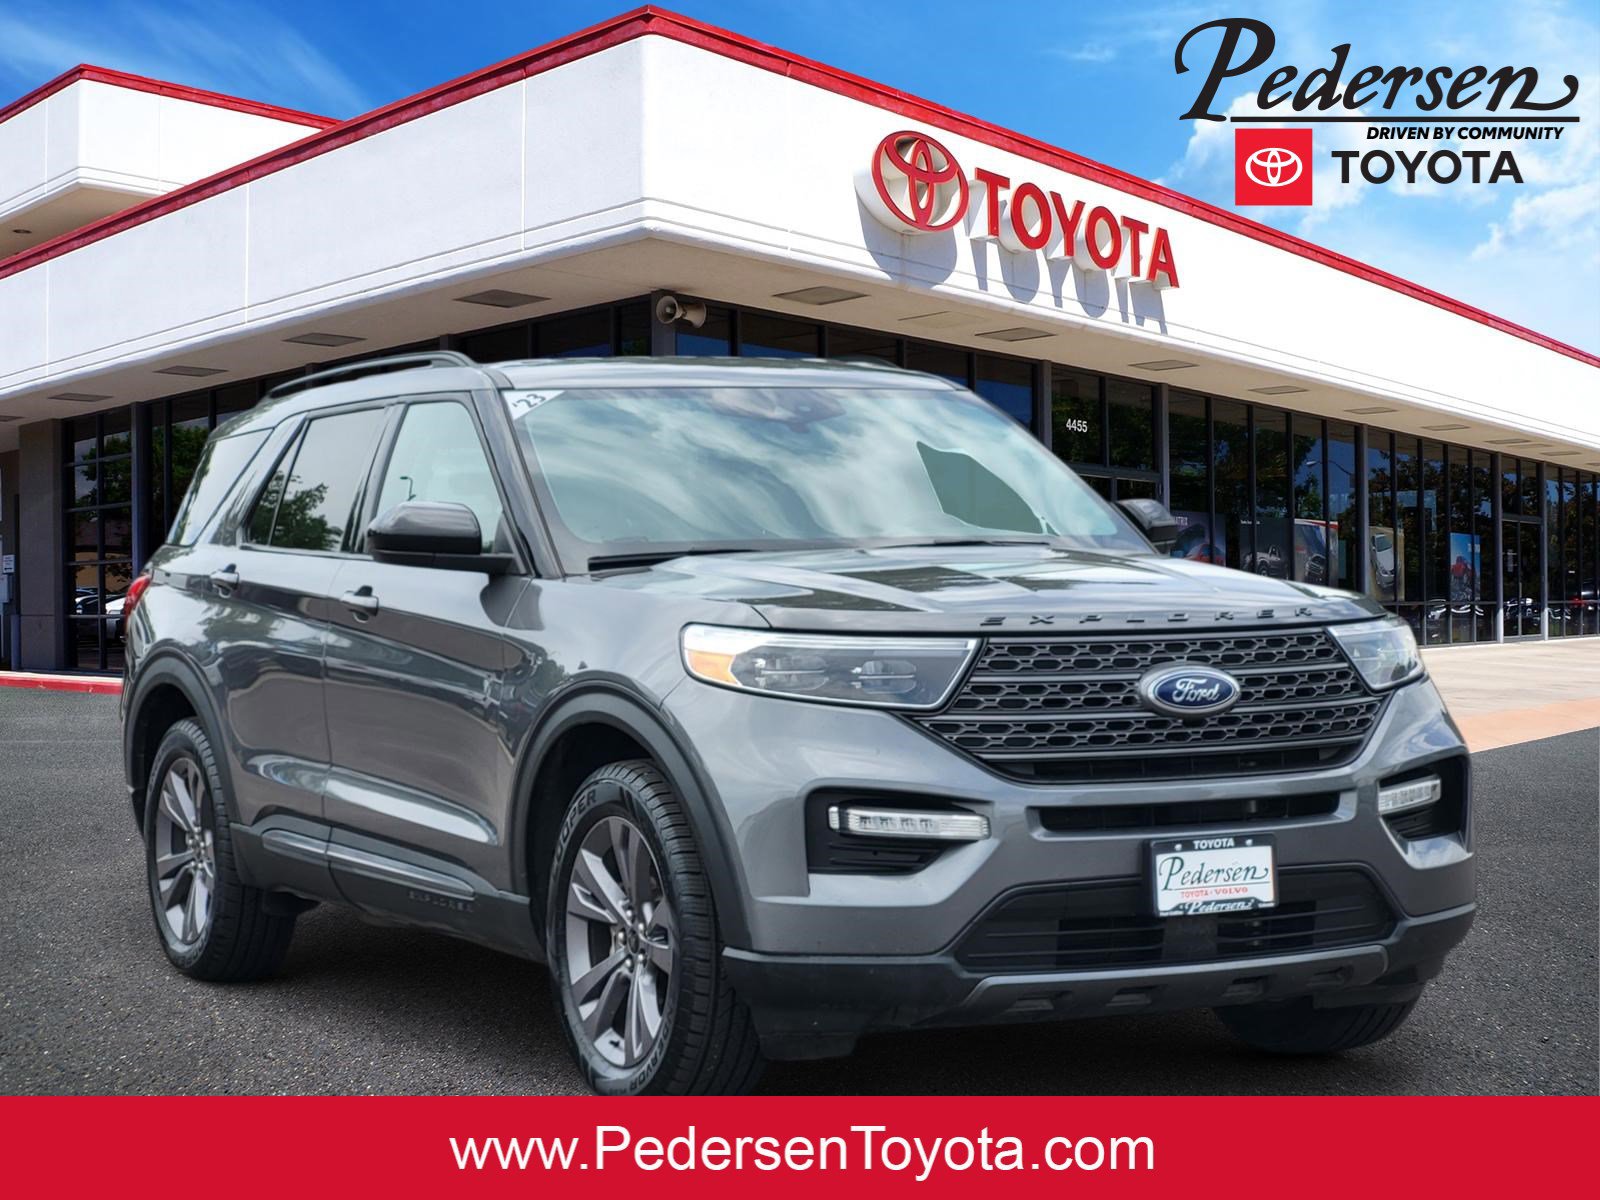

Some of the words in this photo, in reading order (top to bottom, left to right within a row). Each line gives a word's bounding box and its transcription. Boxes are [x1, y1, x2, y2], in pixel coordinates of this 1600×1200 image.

[975, 167, 1180, 289] TOYOTA
[1065, 418, 1088, 433] 4455
[979, 606, 1313, 627] EXPLORER
[1172, 677, 1221, 702] Ford
[1193, 837, 1235, 850] TOYOTA
[1158, 856, 1270, 891] Pedersen
[1181, 890, 1209, 899] TOYOTA
[1215, 886, 1249, 895] VOLVO
